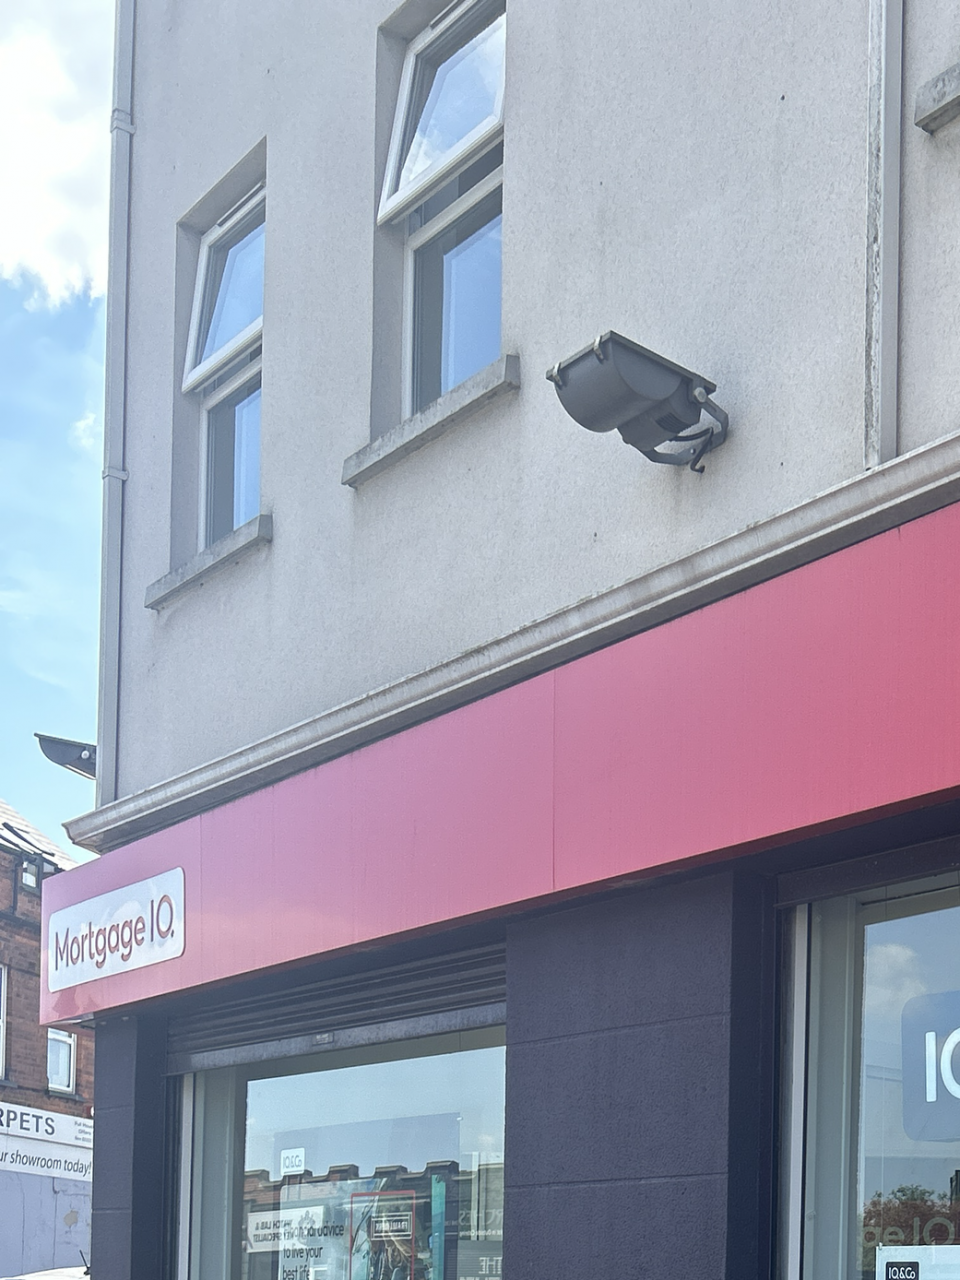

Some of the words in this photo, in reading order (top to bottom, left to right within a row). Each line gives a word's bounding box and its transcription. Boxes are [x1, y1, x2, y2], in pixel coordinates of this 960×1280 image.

[54, 915, 146, 971] Mortgage
[10, 1150, 62, 1170] showroom
[63, 1159, 92, 1178] today!
[317, 1220, 344, 1237] advice
[283, 1244, 291, 1259] to
[291, 1243, 304, 1258] live
[306, 1246, 323, 1262] your
[282, 1264, 298, 1280] best
